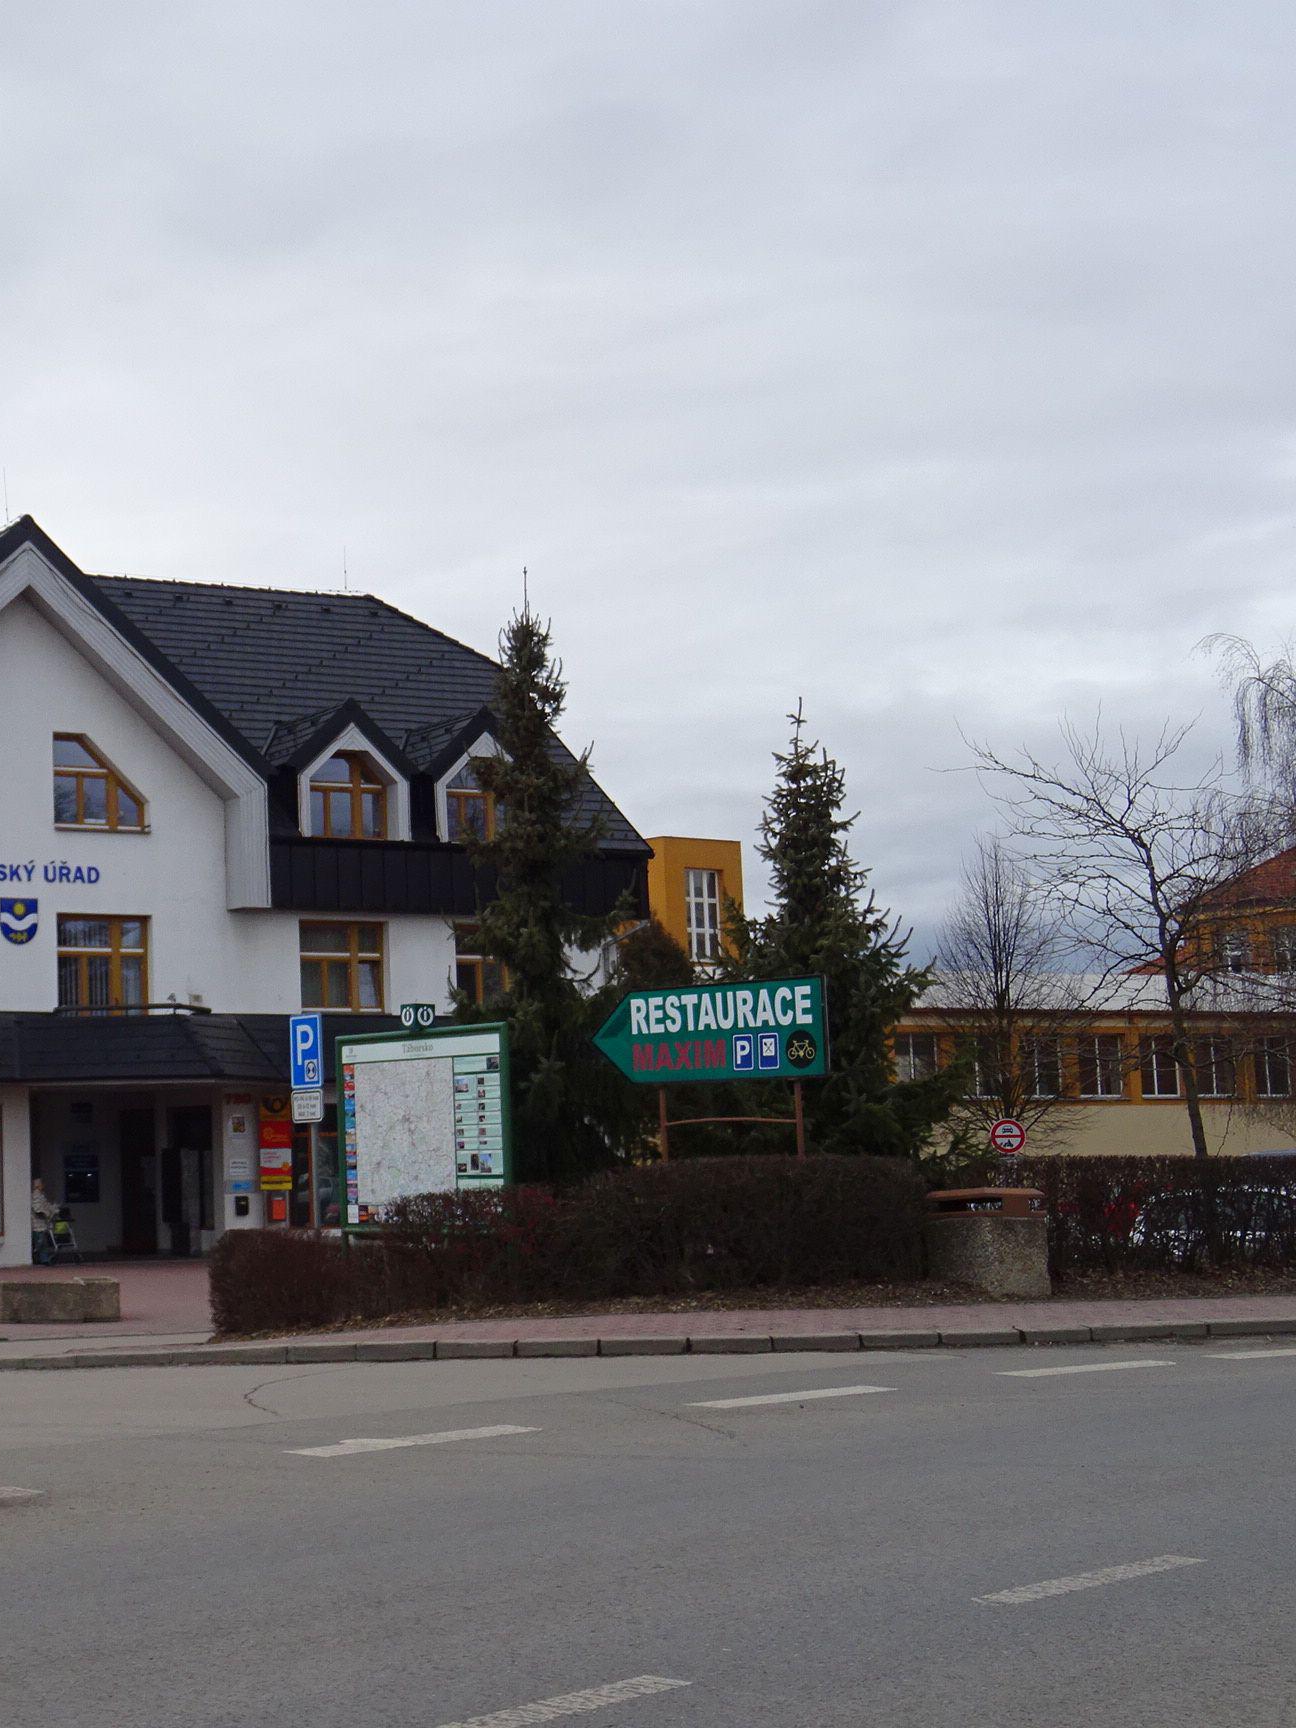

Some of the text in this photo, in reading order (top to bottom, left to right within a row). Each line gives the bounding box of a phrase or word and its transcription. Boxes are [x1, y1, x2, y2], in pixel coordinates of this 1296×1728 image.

[43, 860, 100, 884] ÚŘAD
[630, 985, 813, 1035] RESTAURACE
[296, 1024, 314, 1066] P
[632, 1038, 727, 1072] MAXIM
[736, 1040, 750, 1065] P
